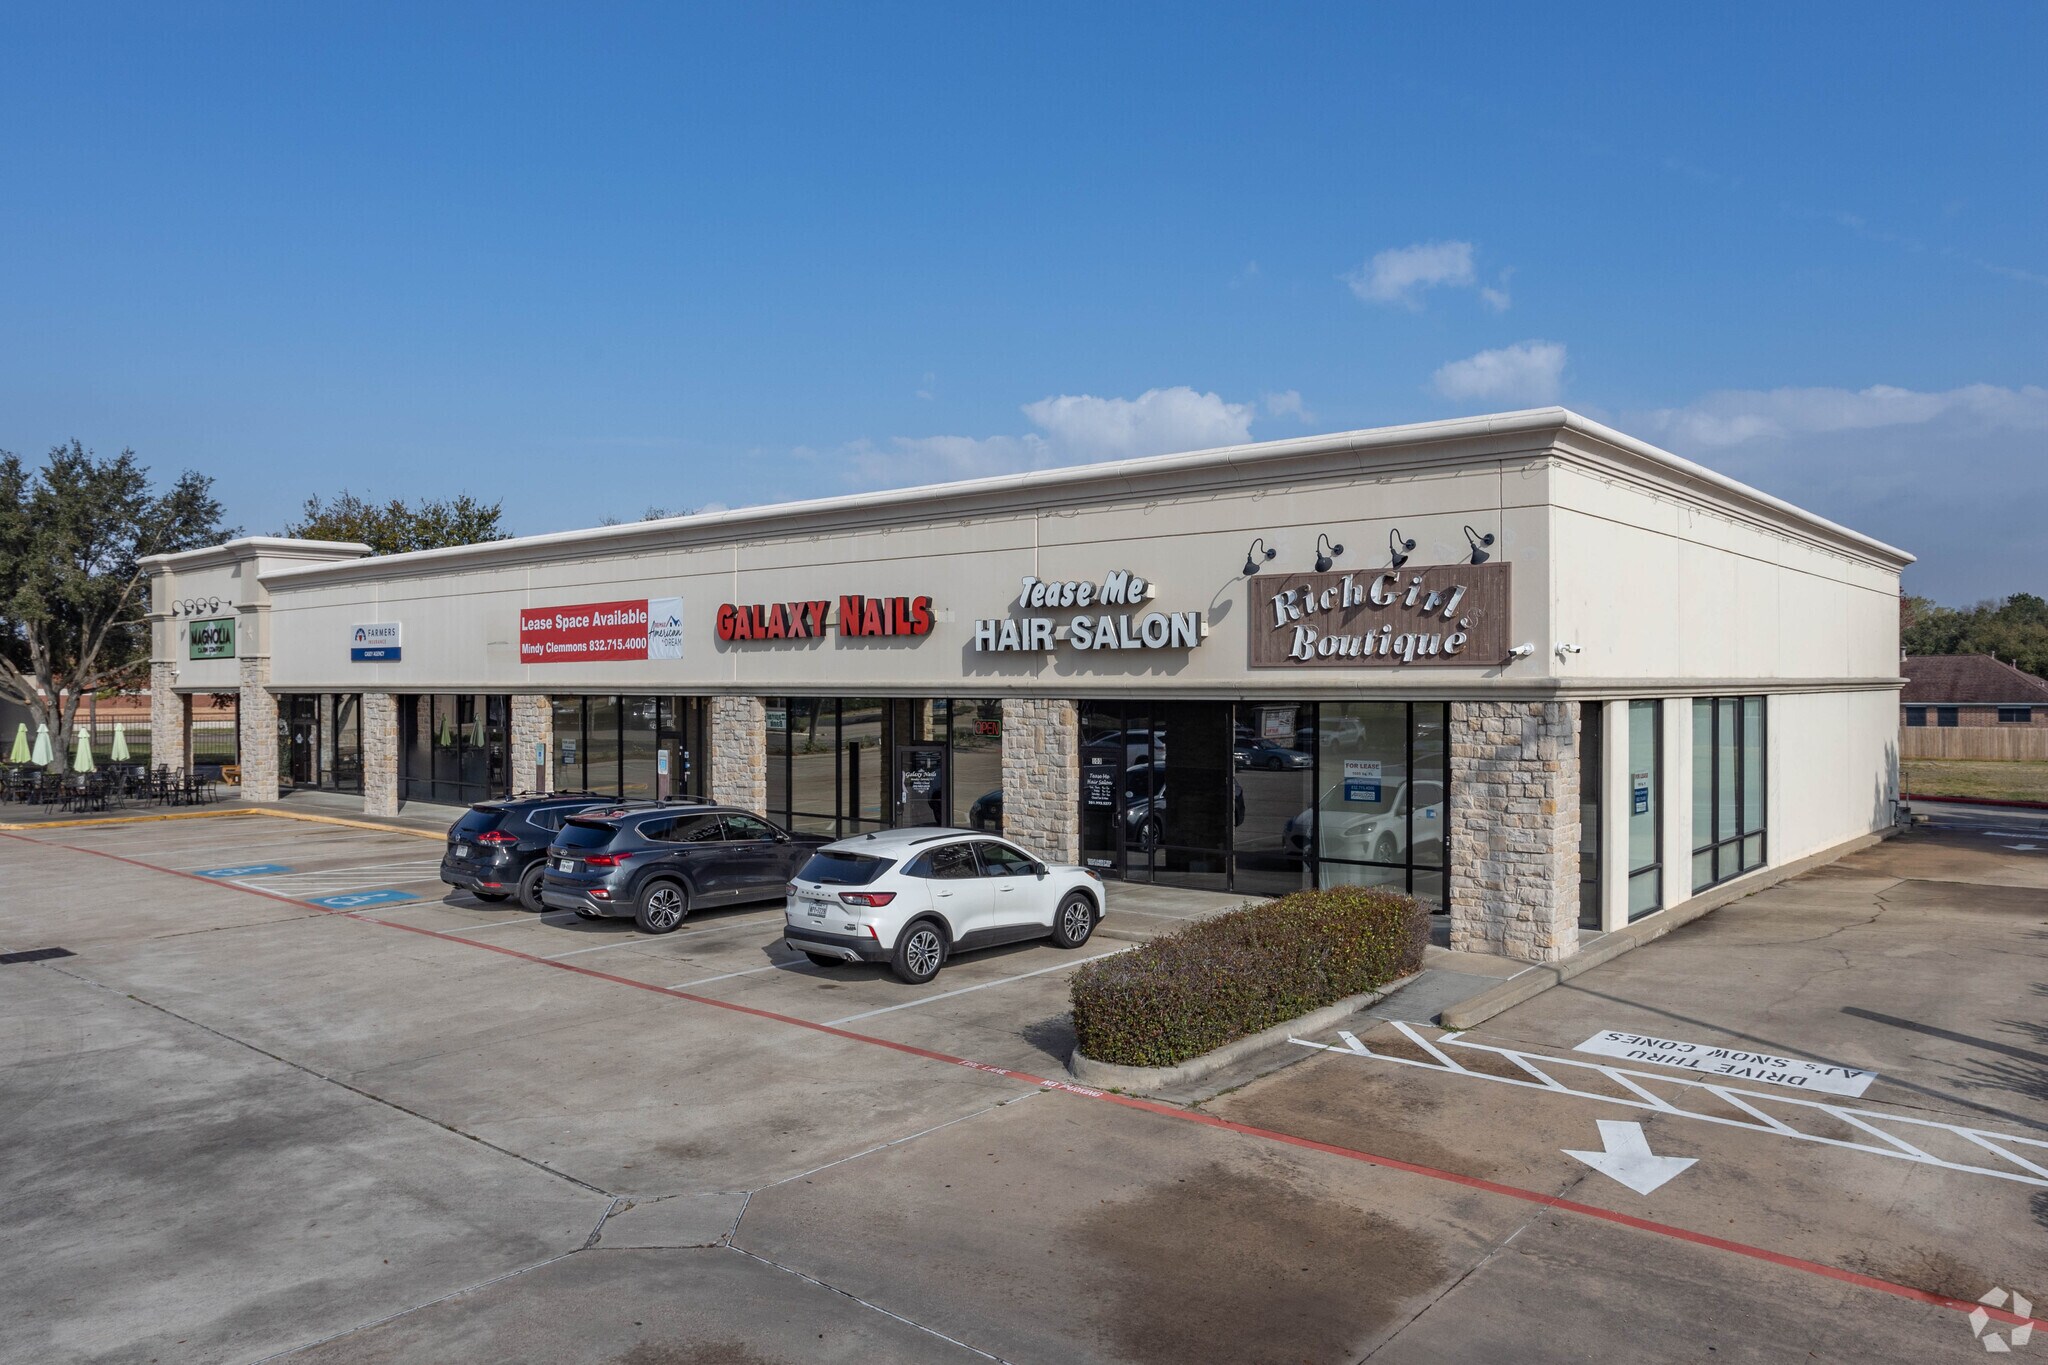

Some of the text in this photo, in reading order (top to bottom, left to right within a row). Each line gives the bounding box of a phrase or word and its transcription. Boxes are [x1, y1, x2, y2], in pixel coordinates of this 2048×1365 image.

[1019, 569, 1148, 608] Tease Me
[522, 609, 647, 632] Lease Space Available
[717, 595, 934, 640] GALAXY NAILS
[191, 626, 231, 646] MAGNOLIA
[367, 628, 396, 637] FARMERS
[649, 620, 682, 639] American
[975, 611, 1201, 651] HAIR SALON
[522, 637, 647, 656] Mindy Clemmons 832.715.4000
[665, 638, 682, 647] DREAM
[1288, 624, 1467, 662] Boutique
[976, 721, 998, 735] OPEN
[1604, 1032, 1697, 1054] CONES
[958, 1060, 1011, 1075] FIRE LANE
[1626, 1050, 1808, 1086] DRIVE THRU
[1707, 1049, 1790, 1069] SNOW
[1040, 1080, 1103, 1098] NO PARKING
